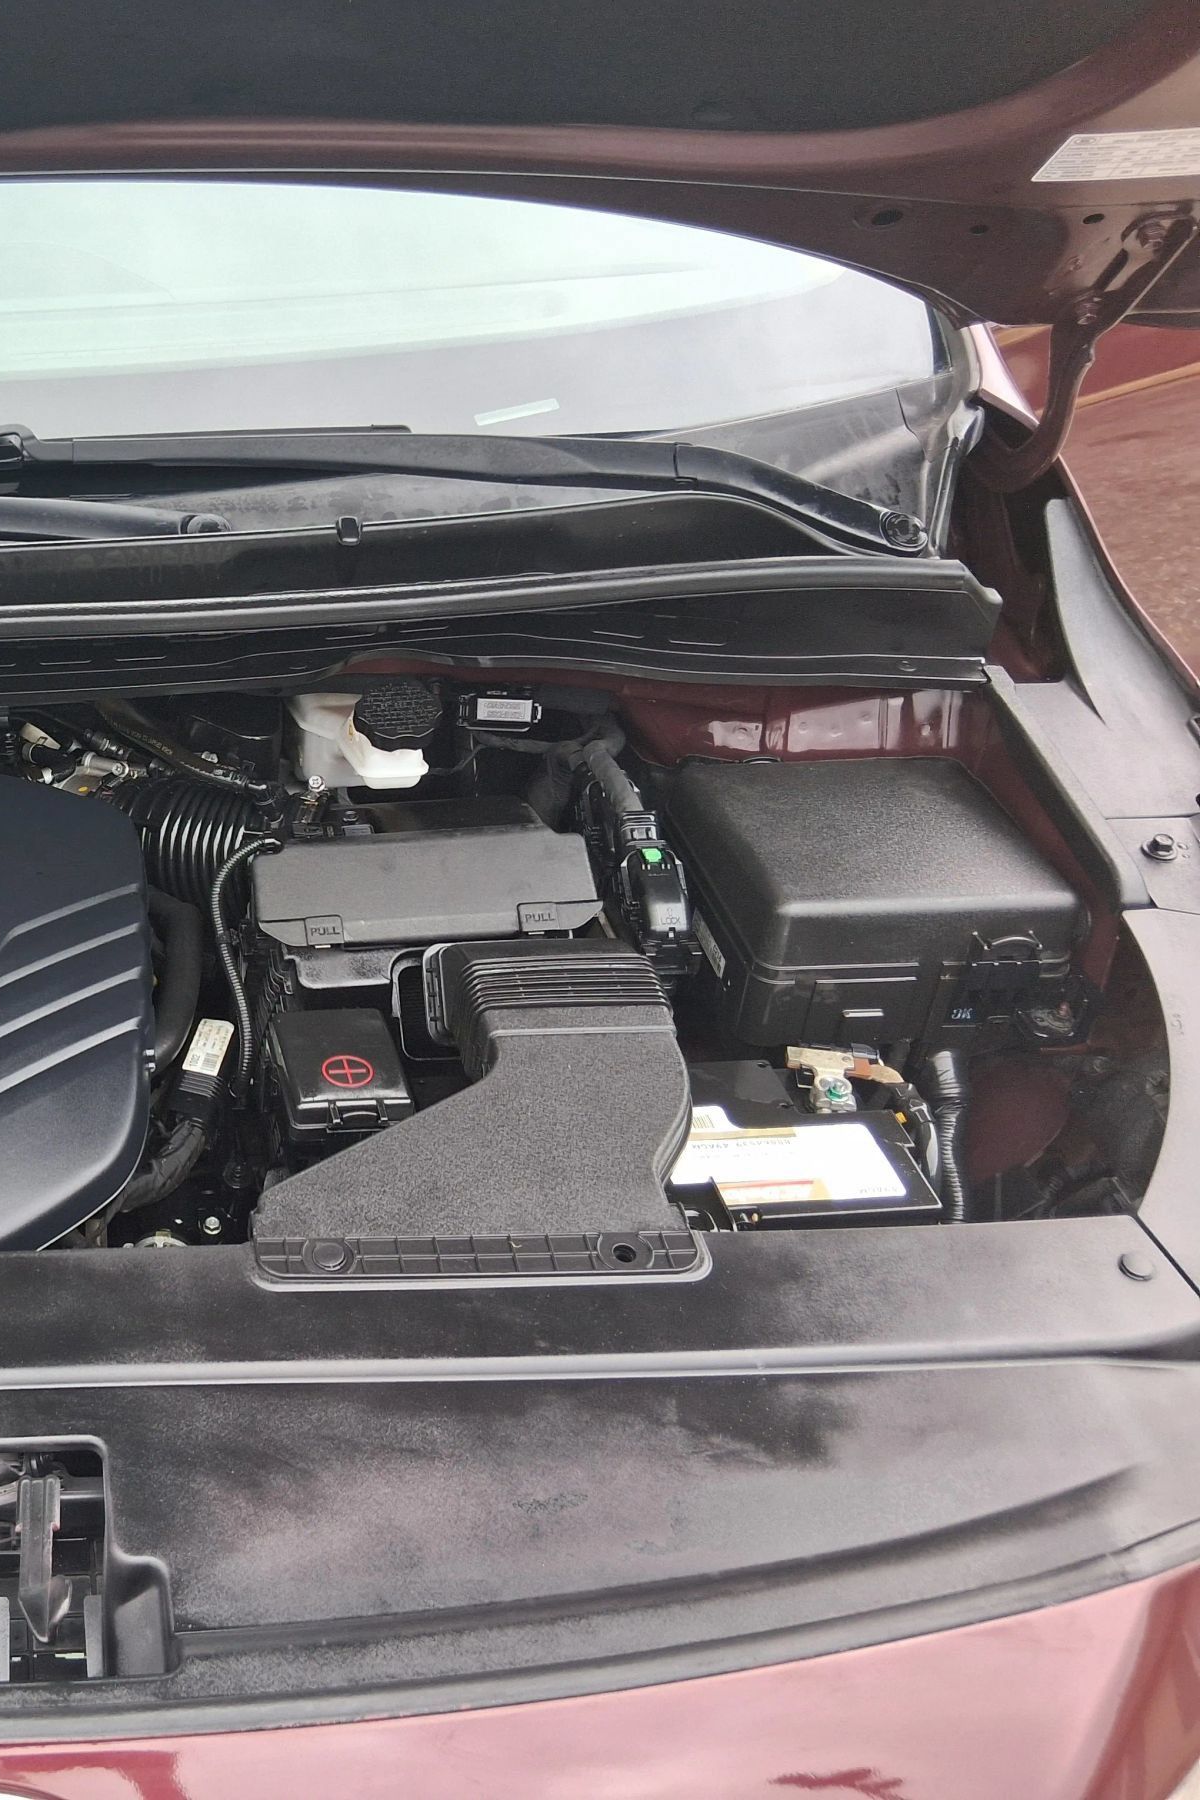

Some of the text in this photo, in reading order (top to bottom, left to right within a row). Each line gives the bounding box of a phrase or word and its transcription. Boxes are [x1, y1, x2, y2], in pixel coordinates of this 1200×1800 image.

[525, 912, 557, 923] PULL
[660, 917, 680, 925] LOCK
[310, 926, 341, 936] PULL
